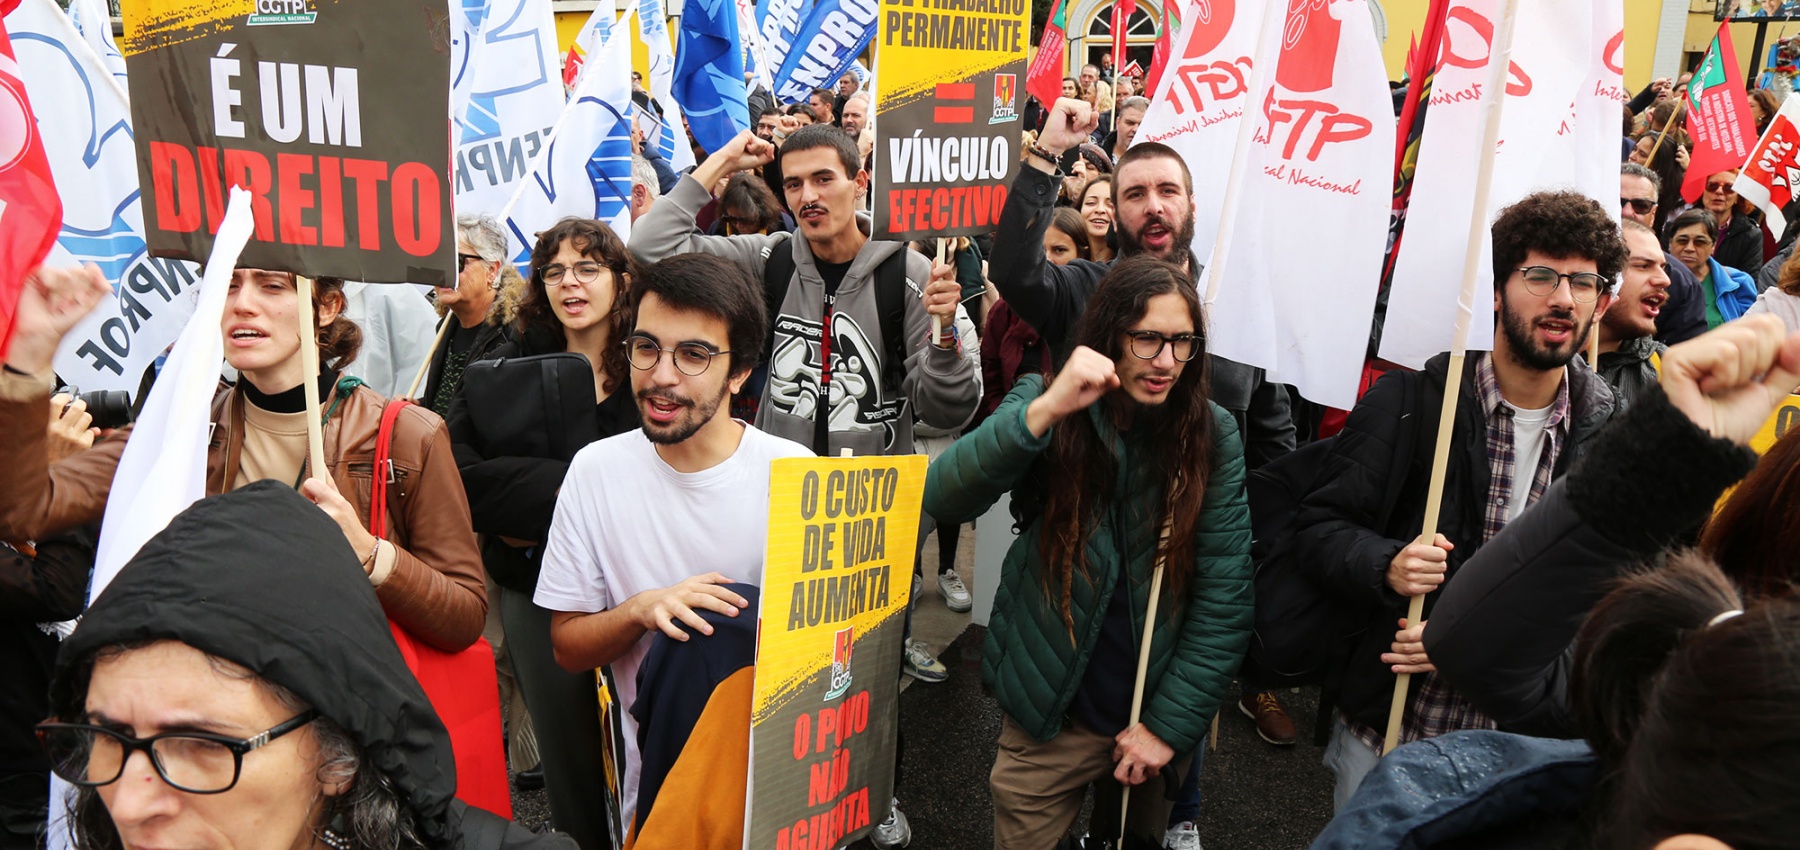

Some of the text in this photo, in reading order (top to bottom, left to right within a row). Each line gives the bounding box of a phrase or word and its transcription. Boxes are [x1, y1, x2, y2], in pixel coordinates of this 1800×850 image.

[259, 0, 304, 14] CGTP
[886, 11, 1022, 52] PERMANENTE
[209, 42, 363, 147] É UM
[994, 107, 1014, 117] CGTP
[889, 129, 1009, 183] VÍNCULO
[1287, 168, 1361, 195] Nacional
[150, 141, 441, 257] DIREITO
[888, 184, 1008, 233] EFECTIVO
[801, 467, 898, 520] O CUSTO
[801, 516, 886, 573] DE VIDA
[787, 565, 890, 631] AUMENTA
[793, 690, 870, 760] O POVO
[808, 748, 850, 807] NÃO
[775, 787, 870, 850] AGUENTA
